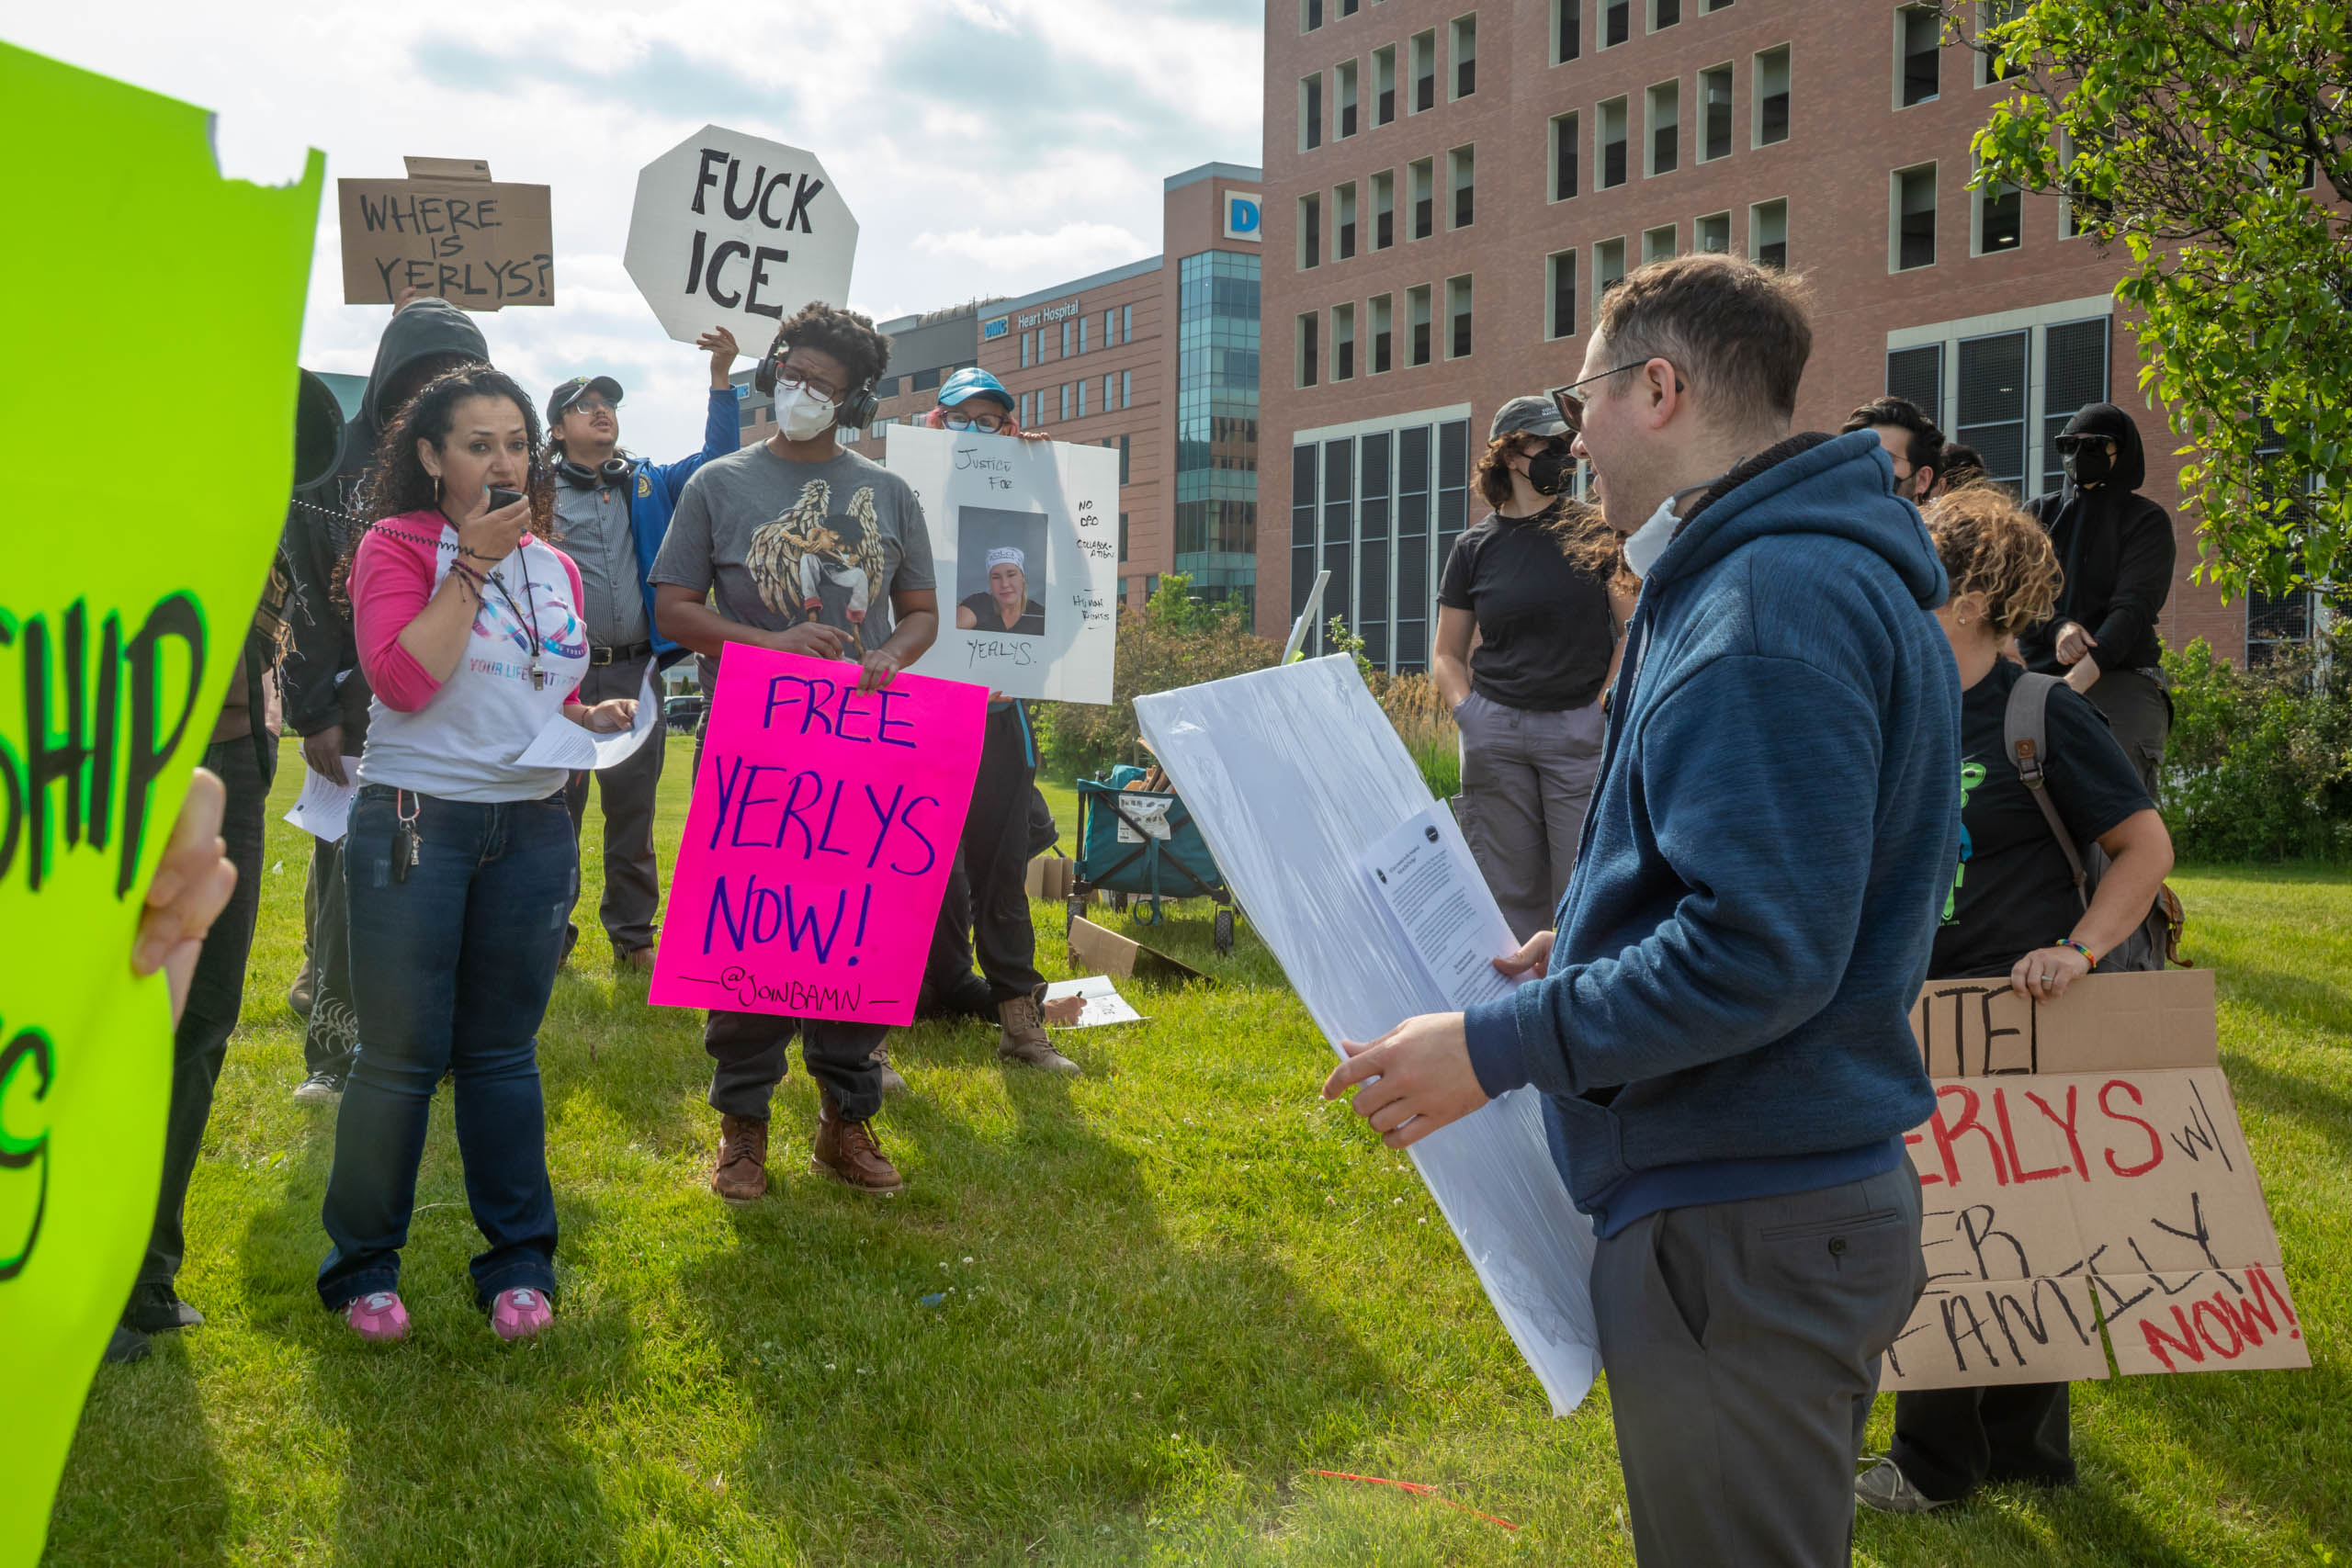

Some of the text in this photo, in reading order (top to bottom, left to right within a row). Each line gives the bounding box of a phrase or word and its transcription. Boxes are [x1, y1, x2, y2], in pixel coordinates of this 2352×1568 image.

[360, 195, 503, 235] WHERE
[692, 148, 824, 233] FUCK
[431, 234, 463, 259] IS
[375, 254, 552, 304] YERLYS?
[685, 230, 788, 319] ICE
[985, 318, 1007, 338] DMC
[1018, 299, 1079, 330] Heart Hospital
[1079, 500, 1093, 512] NO
[470, 658, 503, 677] YOUR
[506, 663, 529, 681] LIFE
[763, 675, 917, 749] FREE
[709, 755, 940, 875] YERLYS
[703, 874, 872, 966] NOW!
[2139, 1261, 2301, 1373] NOW!
